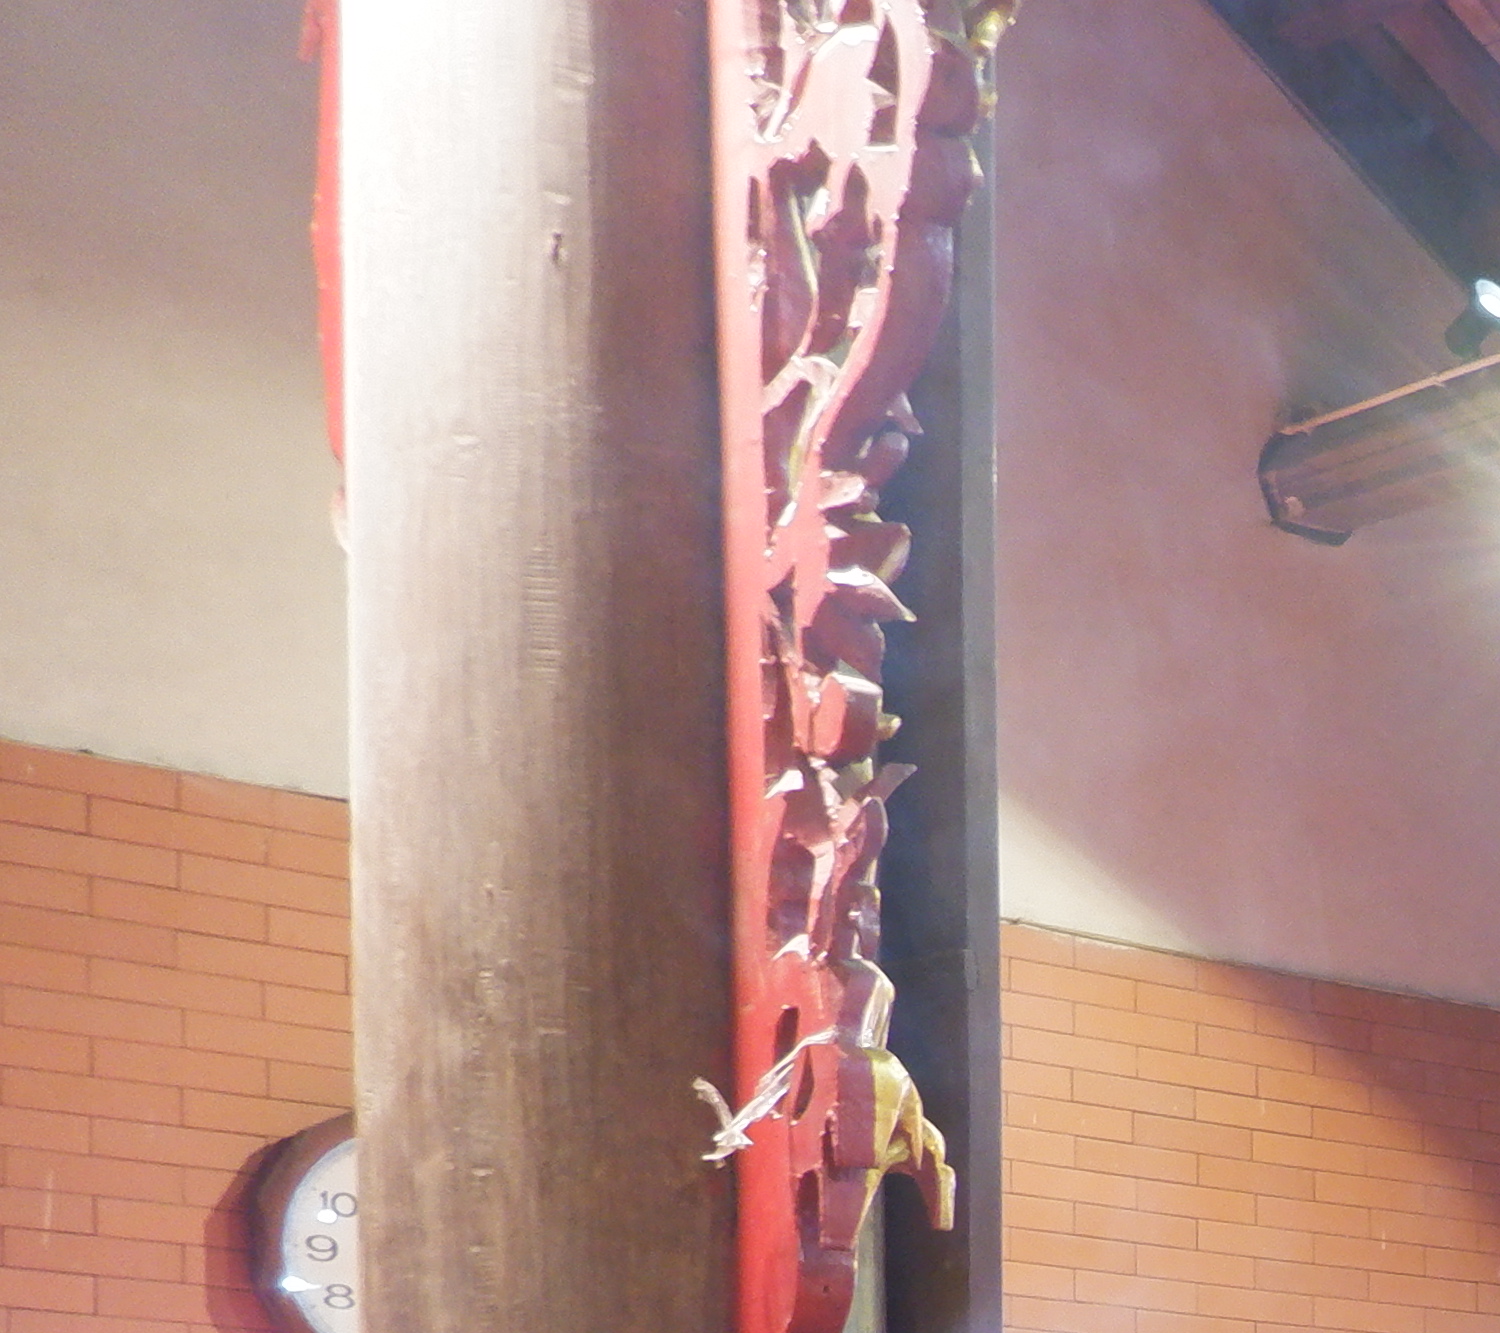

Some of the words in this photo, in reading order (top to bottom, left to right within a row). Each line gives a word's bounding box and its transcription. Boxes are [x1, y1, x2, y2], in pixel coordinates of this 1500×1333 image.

[320, 1191, 358, 1218] 10
[305, 1234, 338, 1262] 9
[323, 1284, 356, 1310] 8
